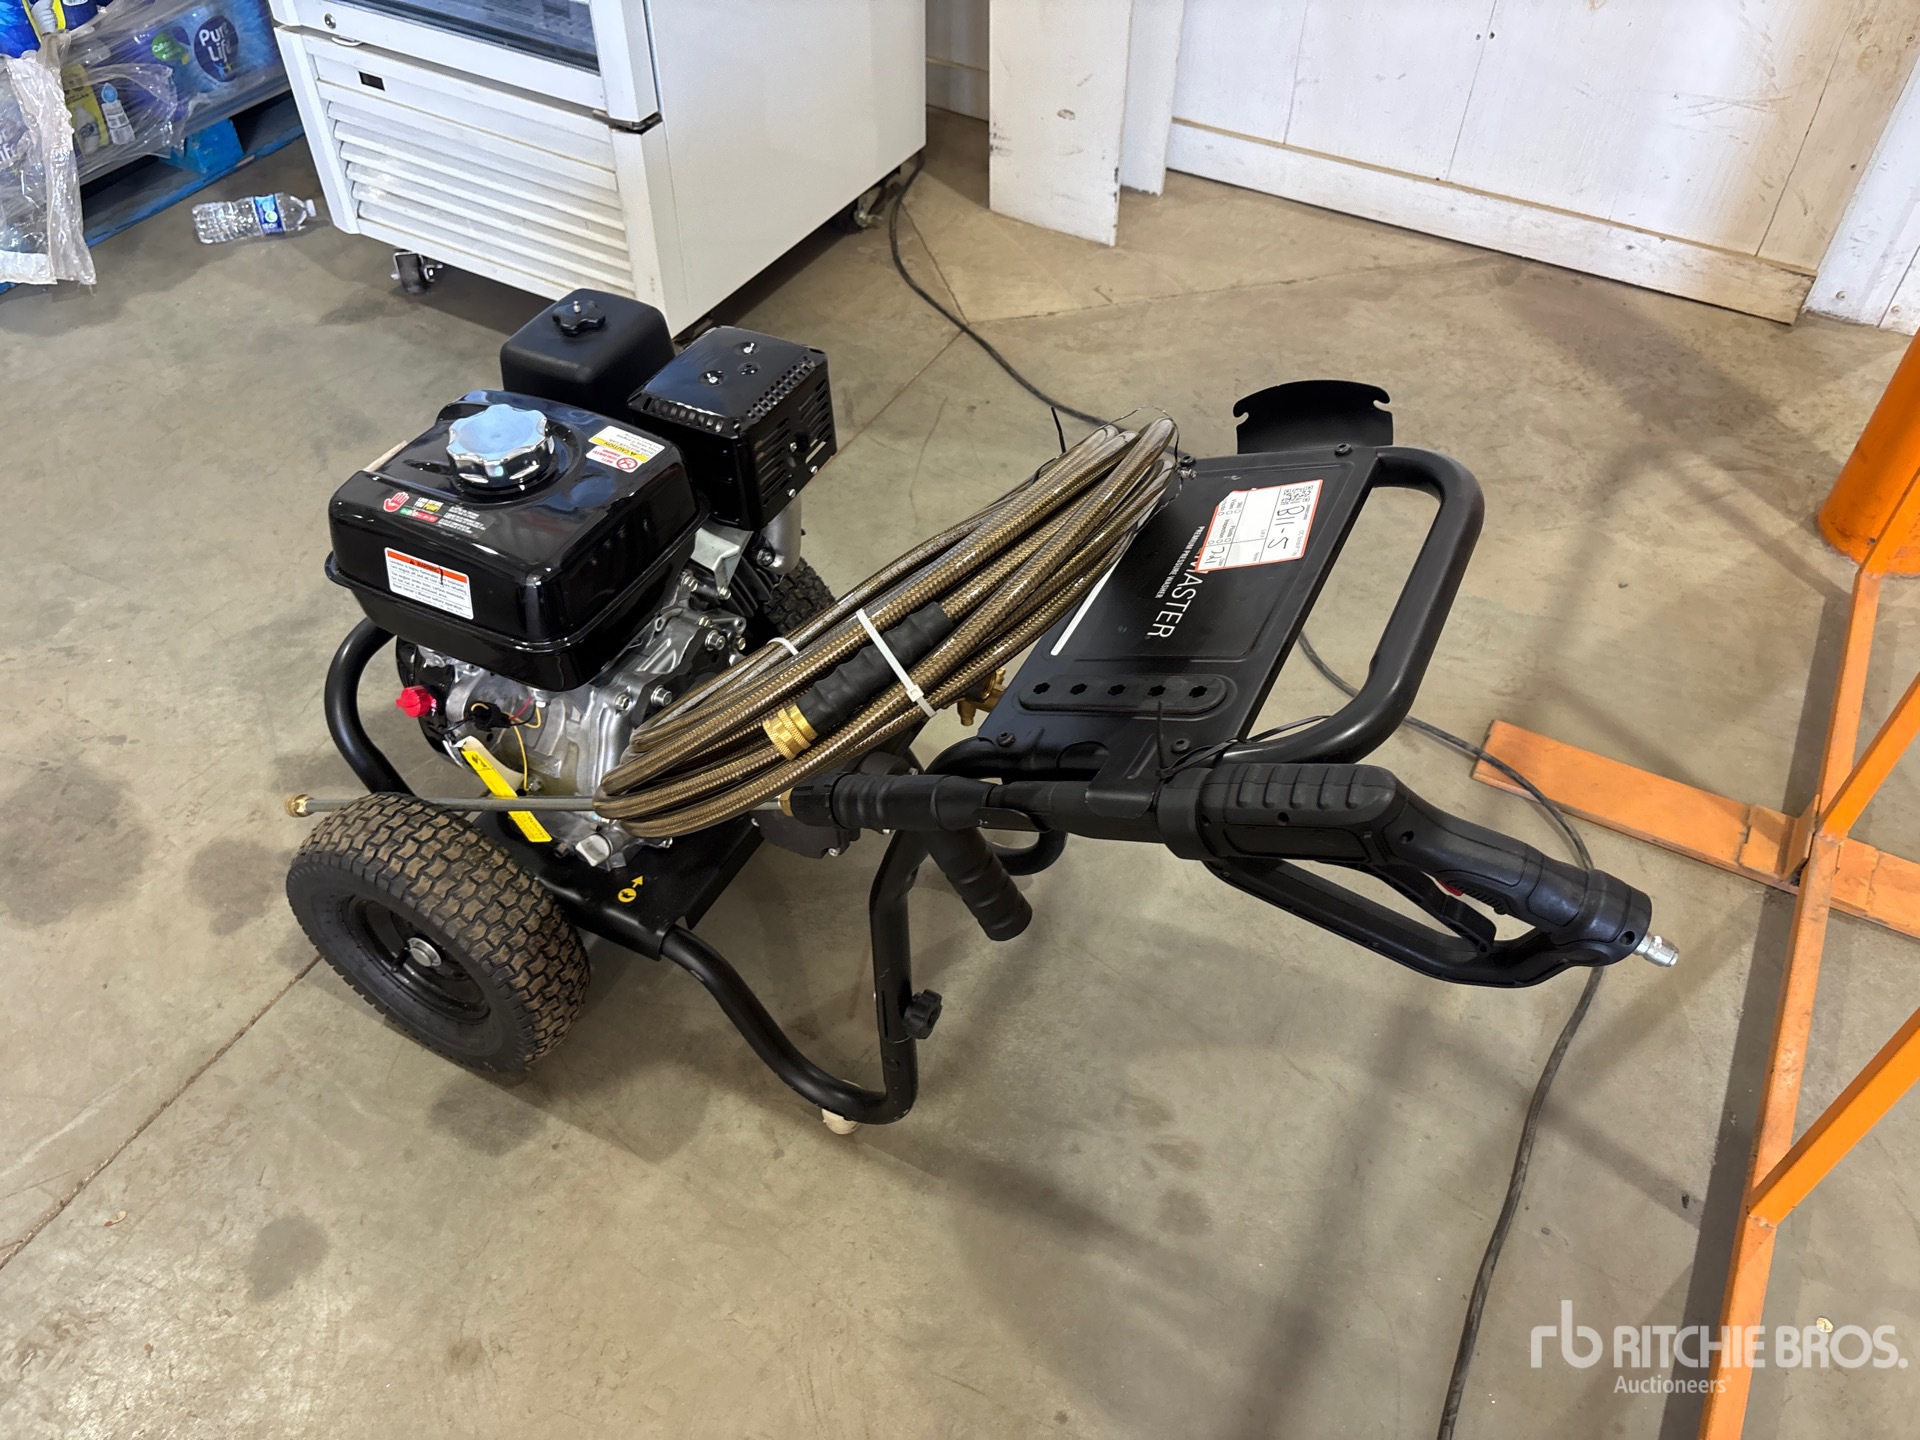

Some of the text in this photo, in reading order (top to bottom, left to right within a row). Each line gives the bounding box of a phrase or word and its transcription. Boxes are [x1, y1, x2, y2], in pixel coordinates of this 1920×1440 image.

[1155, 526, 1206, 599] PREMIUM PRESSURE WASHER
